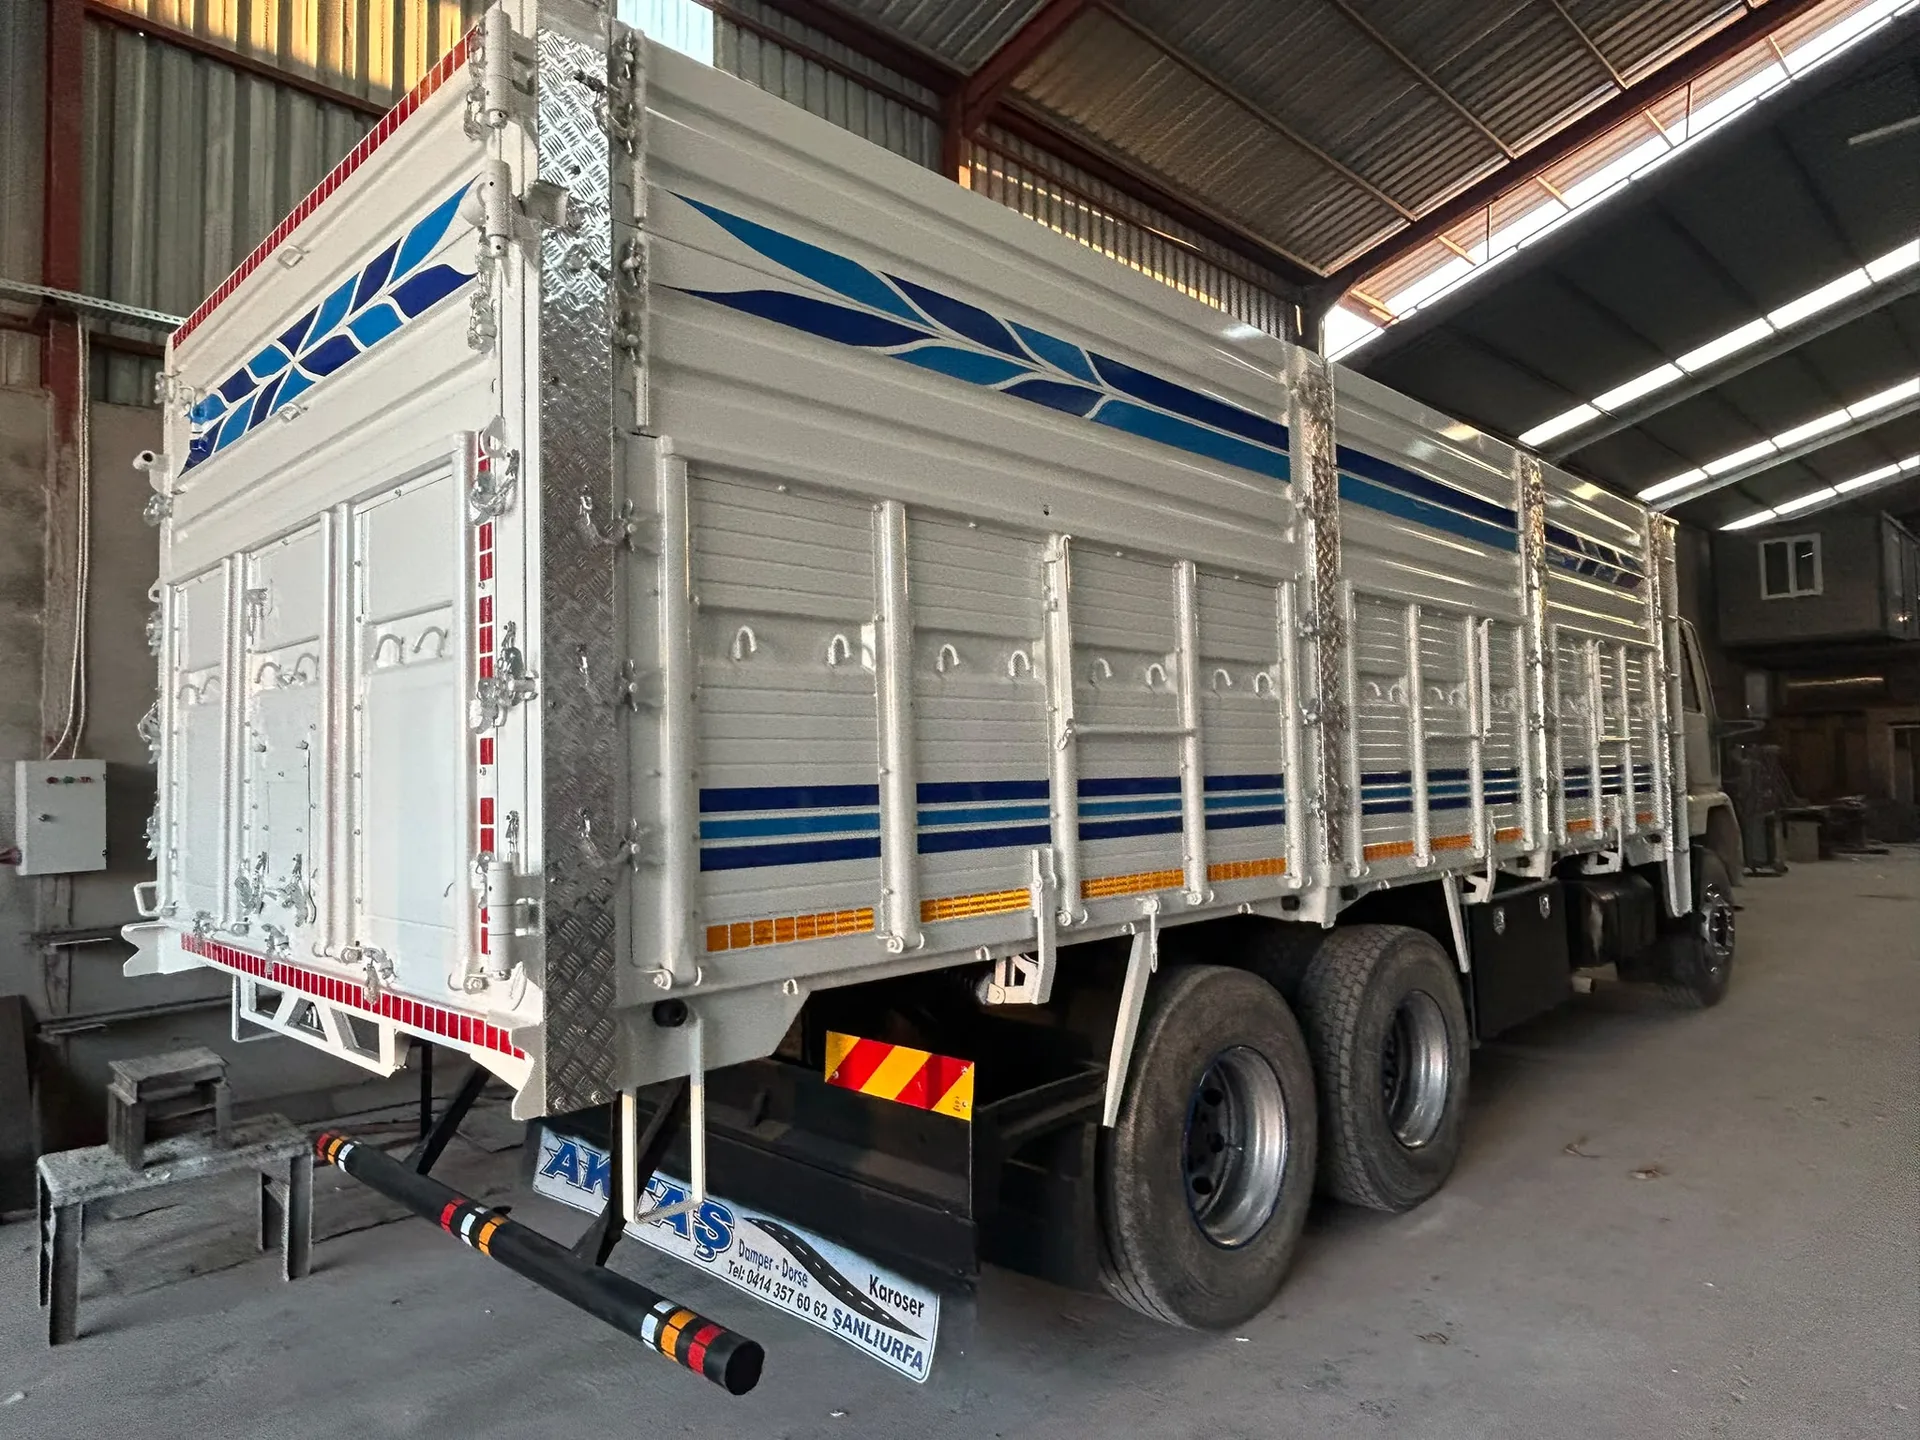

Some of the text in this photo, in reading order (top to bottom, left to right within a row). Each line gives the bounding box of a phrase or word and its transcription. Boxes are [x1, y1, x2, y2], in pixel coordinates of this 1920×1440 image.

[540, 1136, 735, 1262] AKAŞ
[738, 1238, 773, 1271] Damper
[781, 1257, 808, 1288] Dorse
[869, 1273, 925, 1318] Karoser
[728, 1259, 923, 1373] Tel: 0414 357 60 62 ŞANLIURFA
